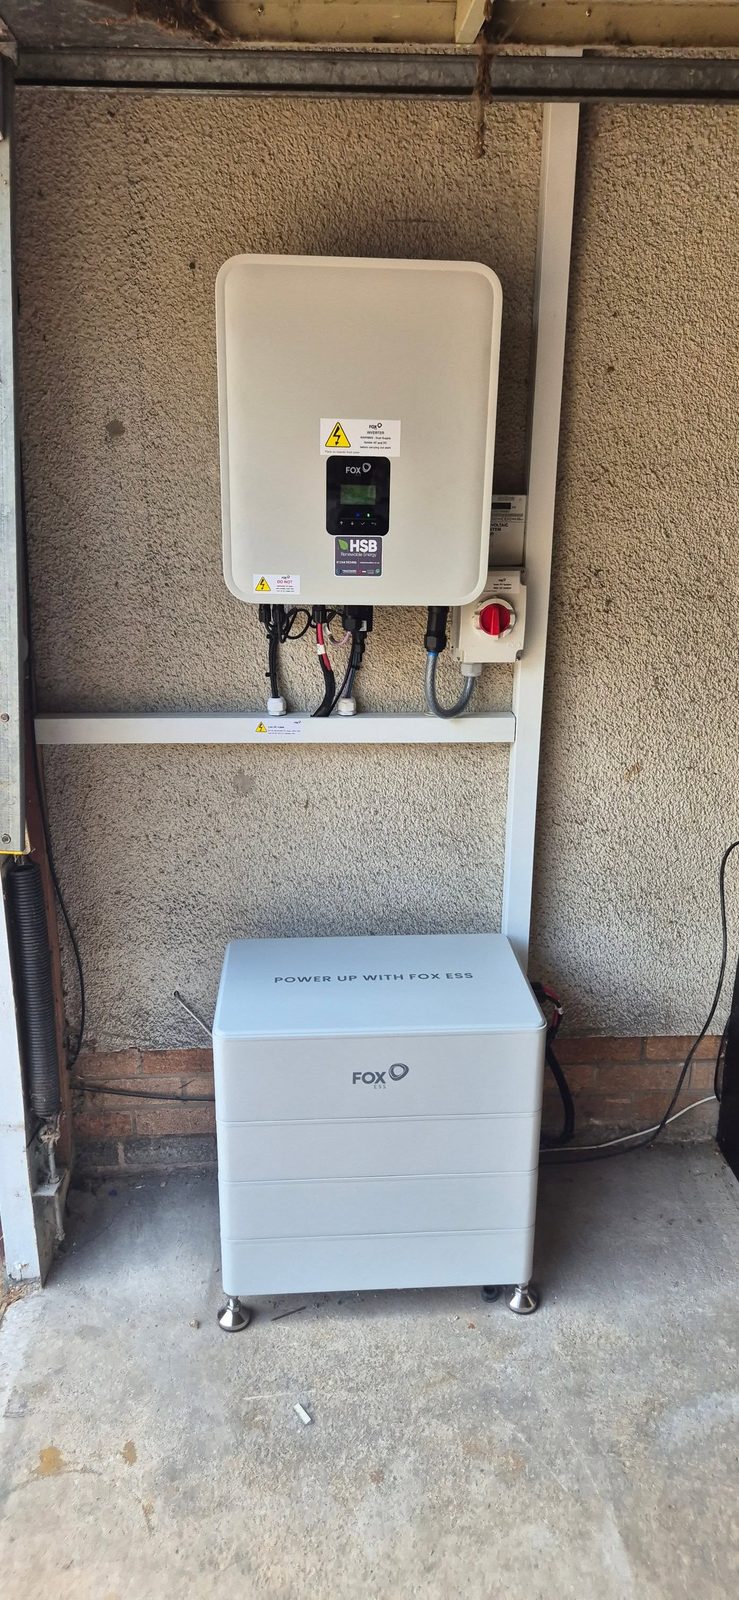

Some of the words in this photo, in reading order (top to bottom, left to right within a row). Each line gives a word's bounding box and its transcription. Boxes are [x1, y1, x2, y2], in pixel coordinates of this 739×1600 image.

[346, 466, 361, 474] FOX
[350, 539, 377, 552] HSB
[274, 975, 331, 983] POWER
[352, 1071, 386, 1084] FOX
